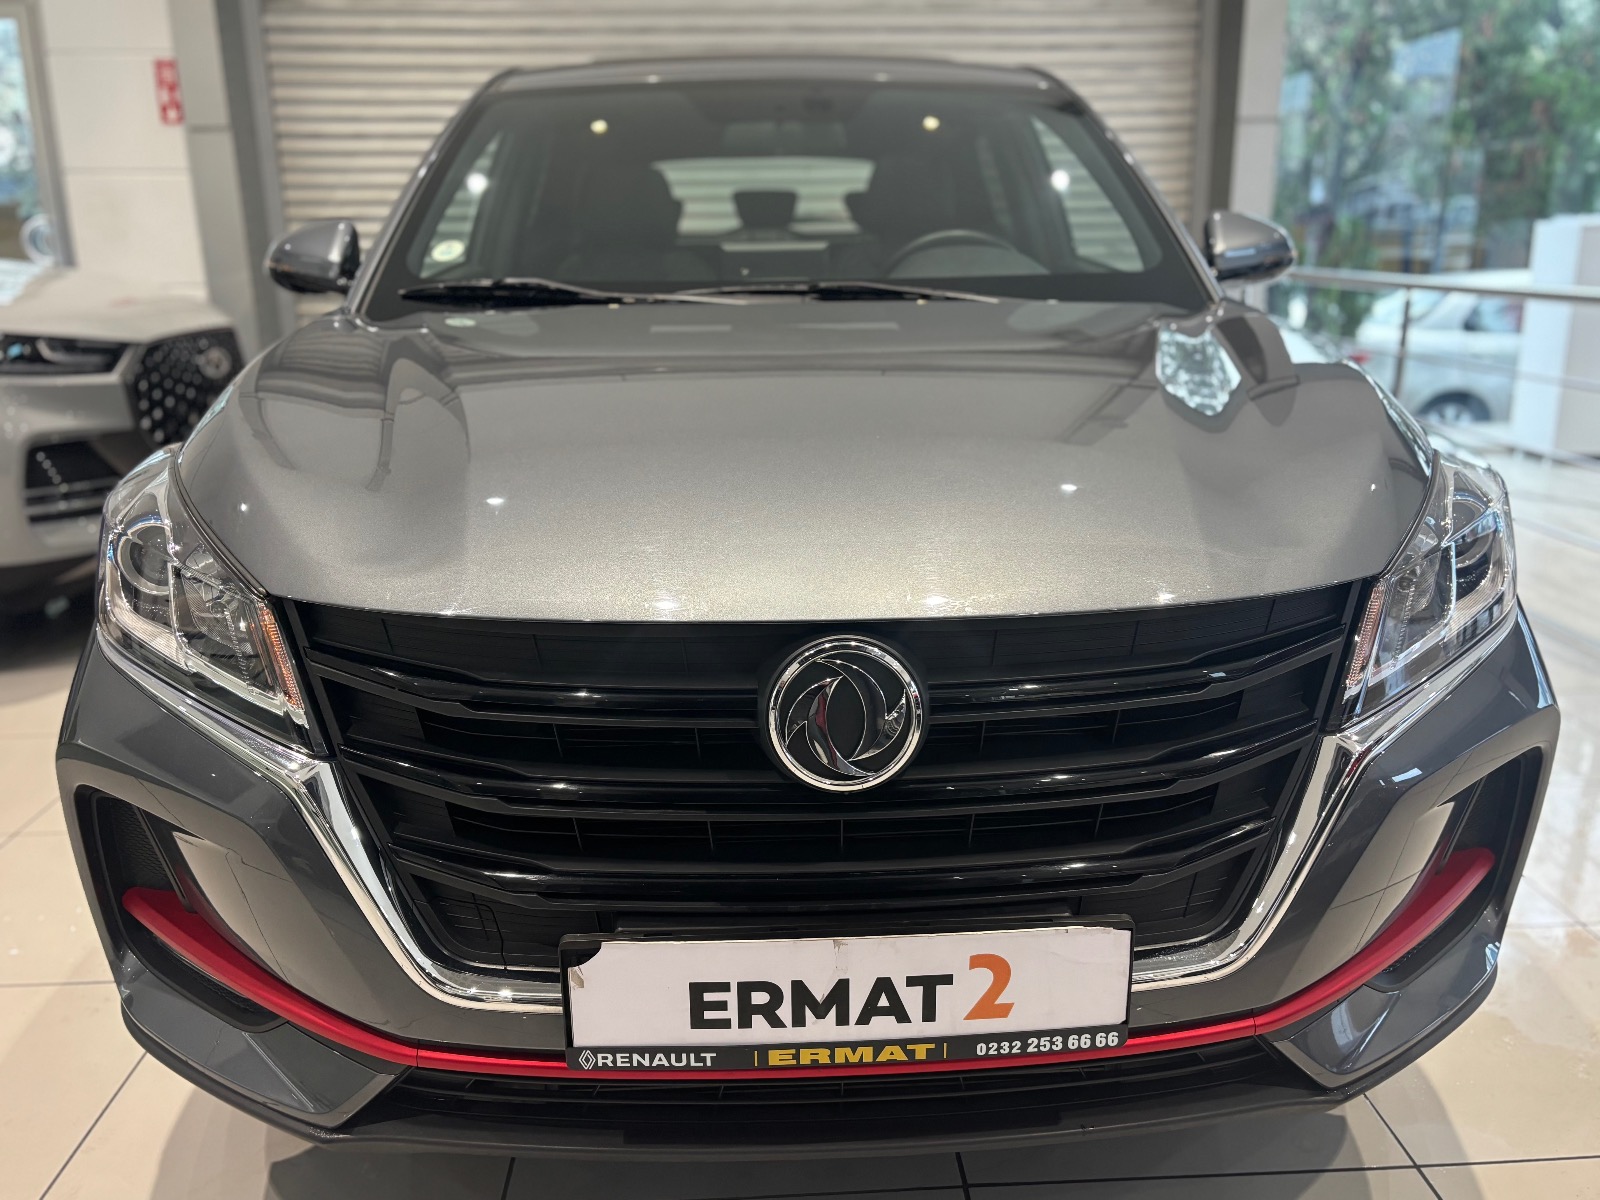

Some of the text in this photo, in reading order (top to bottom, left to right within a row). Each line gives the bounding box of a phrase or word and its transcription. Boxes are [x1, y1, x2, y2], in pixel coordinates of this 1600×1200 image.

[688, 952, 1015, 1030] ERMAT 2
[768, 1043, 936, 1066] ERMAT
[976, 1031, 1119, 1056] 0232 253 66 66
[597, 1053, 717, 1067] RENAULT
